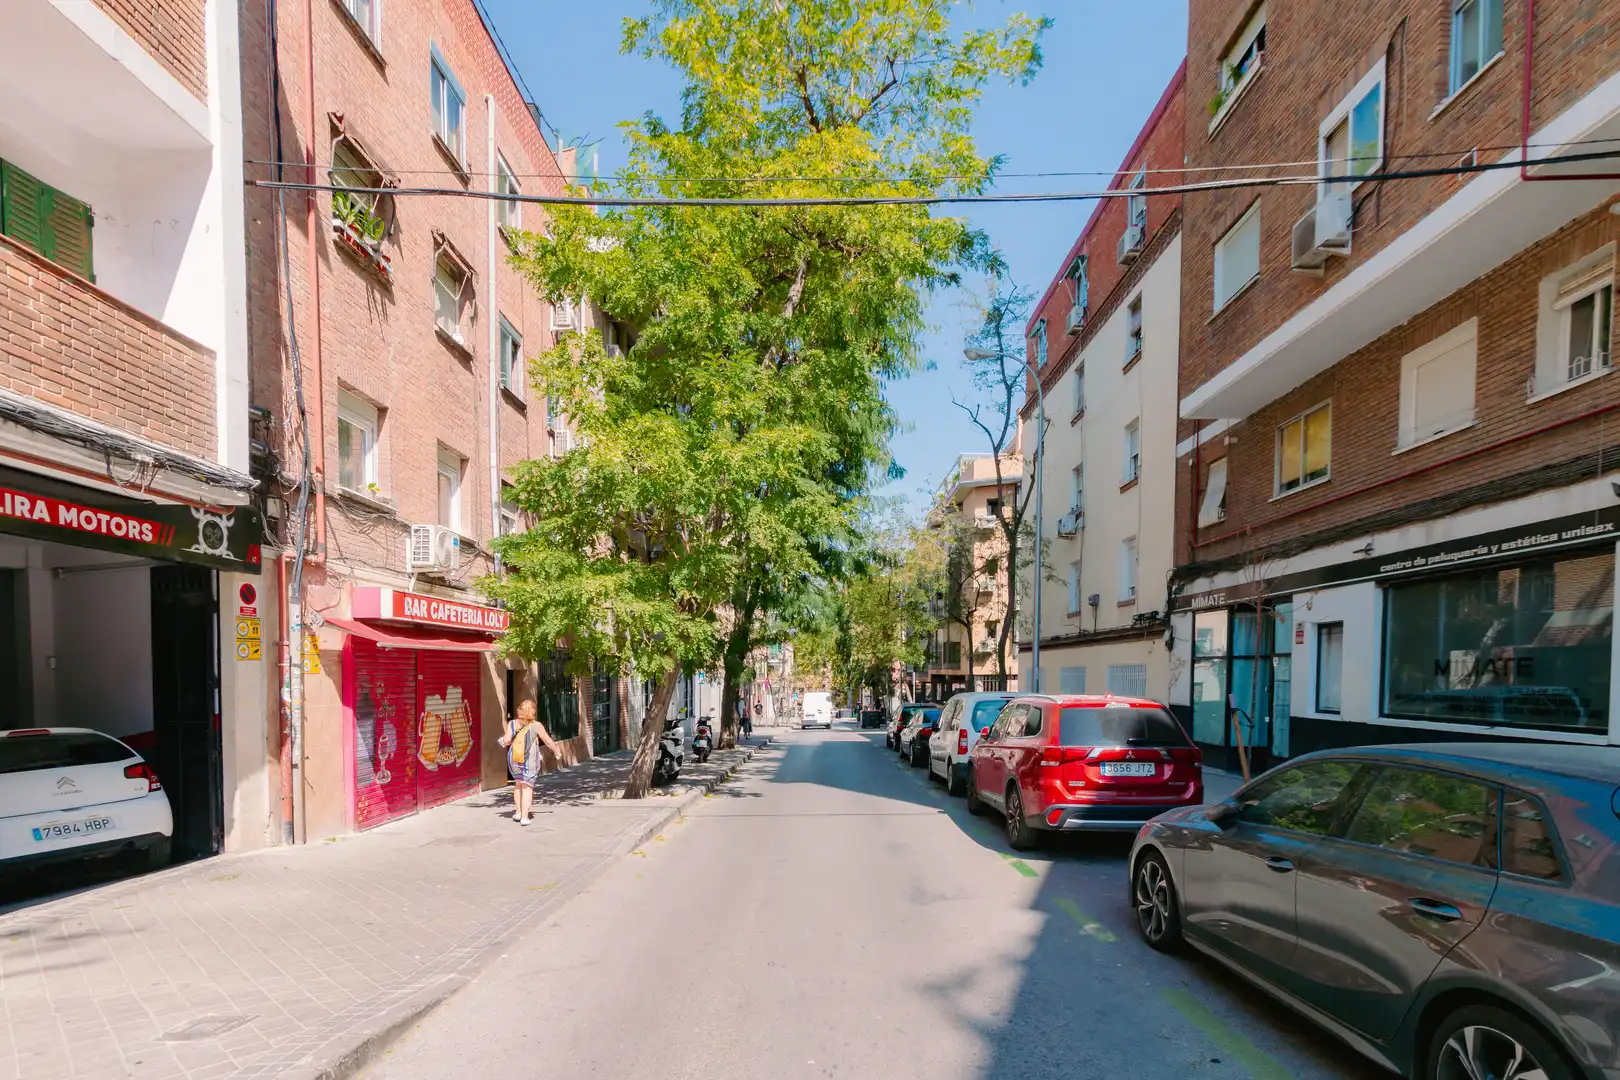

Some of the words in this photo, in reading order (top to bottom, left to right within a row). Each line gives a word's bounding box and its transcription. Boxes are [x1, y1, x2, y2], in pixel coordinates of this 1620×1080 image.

[0, 493, 51, 522] IRA
[58, 504, 153, 542] MOTORS
[1380, 561, 1412, 572] centro
[1413, 556, 1427, 566] de
[1428, 545, 1489, 566] peluquería
[1490, 543, 1500, 554] y
[1501, 532, 1559, 550] estética
[1561, 521, 1615, 539] unisex
[404, 597, 428, 618] BAR
[430, 601, 483, 626] CAFETERIA
[484, 610, 504, 628] LOLY
[1107, 763, 1132, 773] 3656
[1134, 763, 1152, 773] JTZ
[43, 823, 80, 838] 7984
[84, 818, 110, 832] HBP
